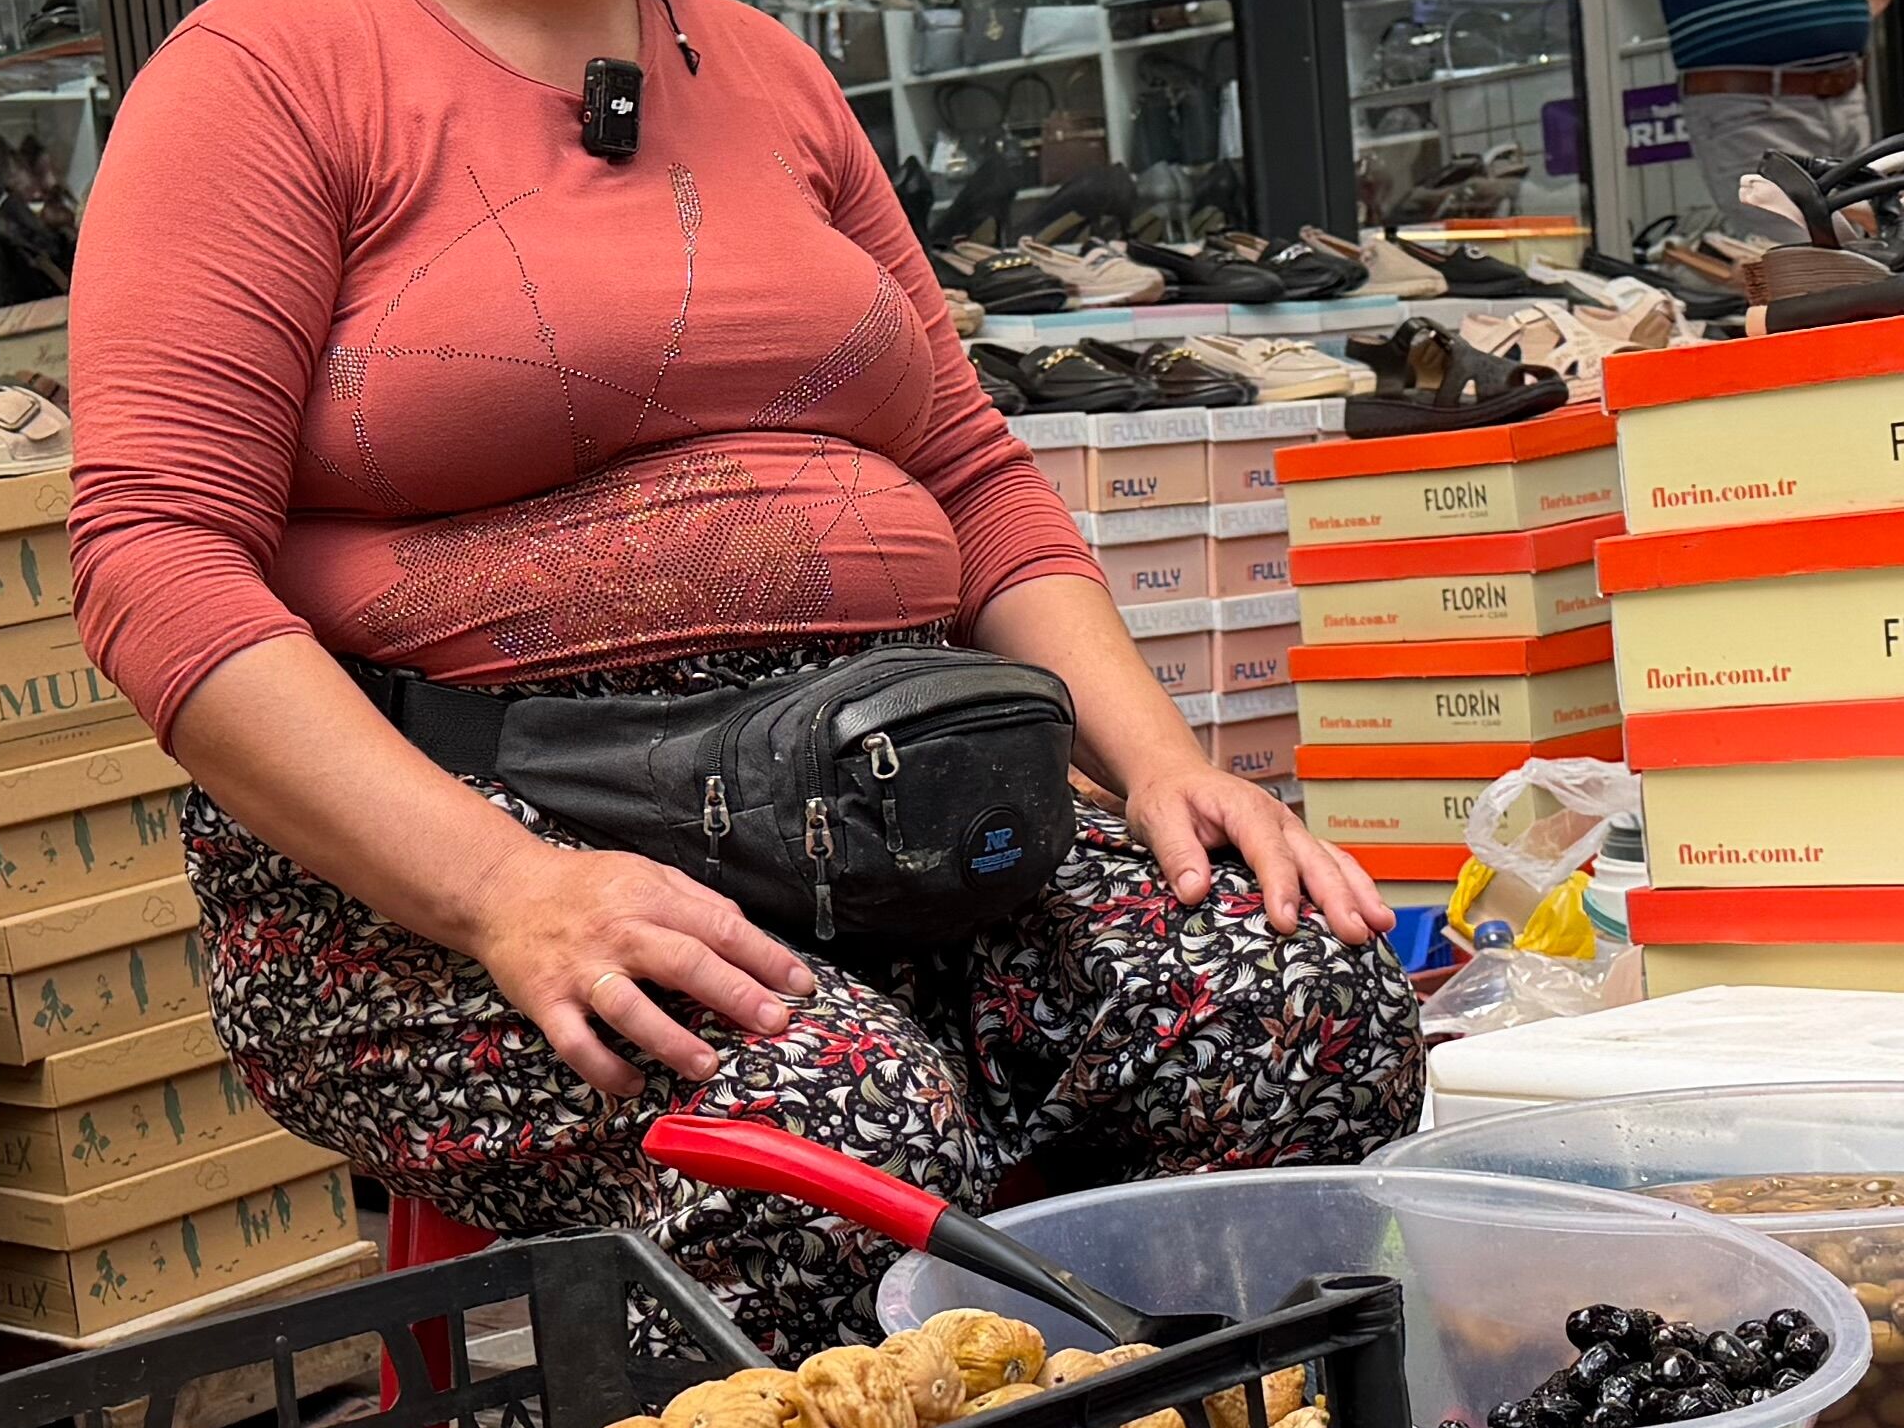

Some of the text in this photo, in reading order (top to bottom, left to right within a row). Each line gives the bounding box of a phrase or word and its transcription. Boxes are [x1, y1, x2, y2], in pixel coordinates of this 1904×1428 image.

[1248, 470, 1275, 487] FUL
[1424, 480, 1488, 513] FLORİN
[1651, 478, 1797, 509] florin.com.tr
[1252, 562, 1287, 582] FULL
[1442, 580, 1507, 612] FLORİN
[1154, 663, 1186, 684] ULLY
[1646, 664, 1792, 691] florin.com.tr
[1436, 689, 1500, 718] FLORİN
[1679, 842, 1824, 865] florin.com.tr
